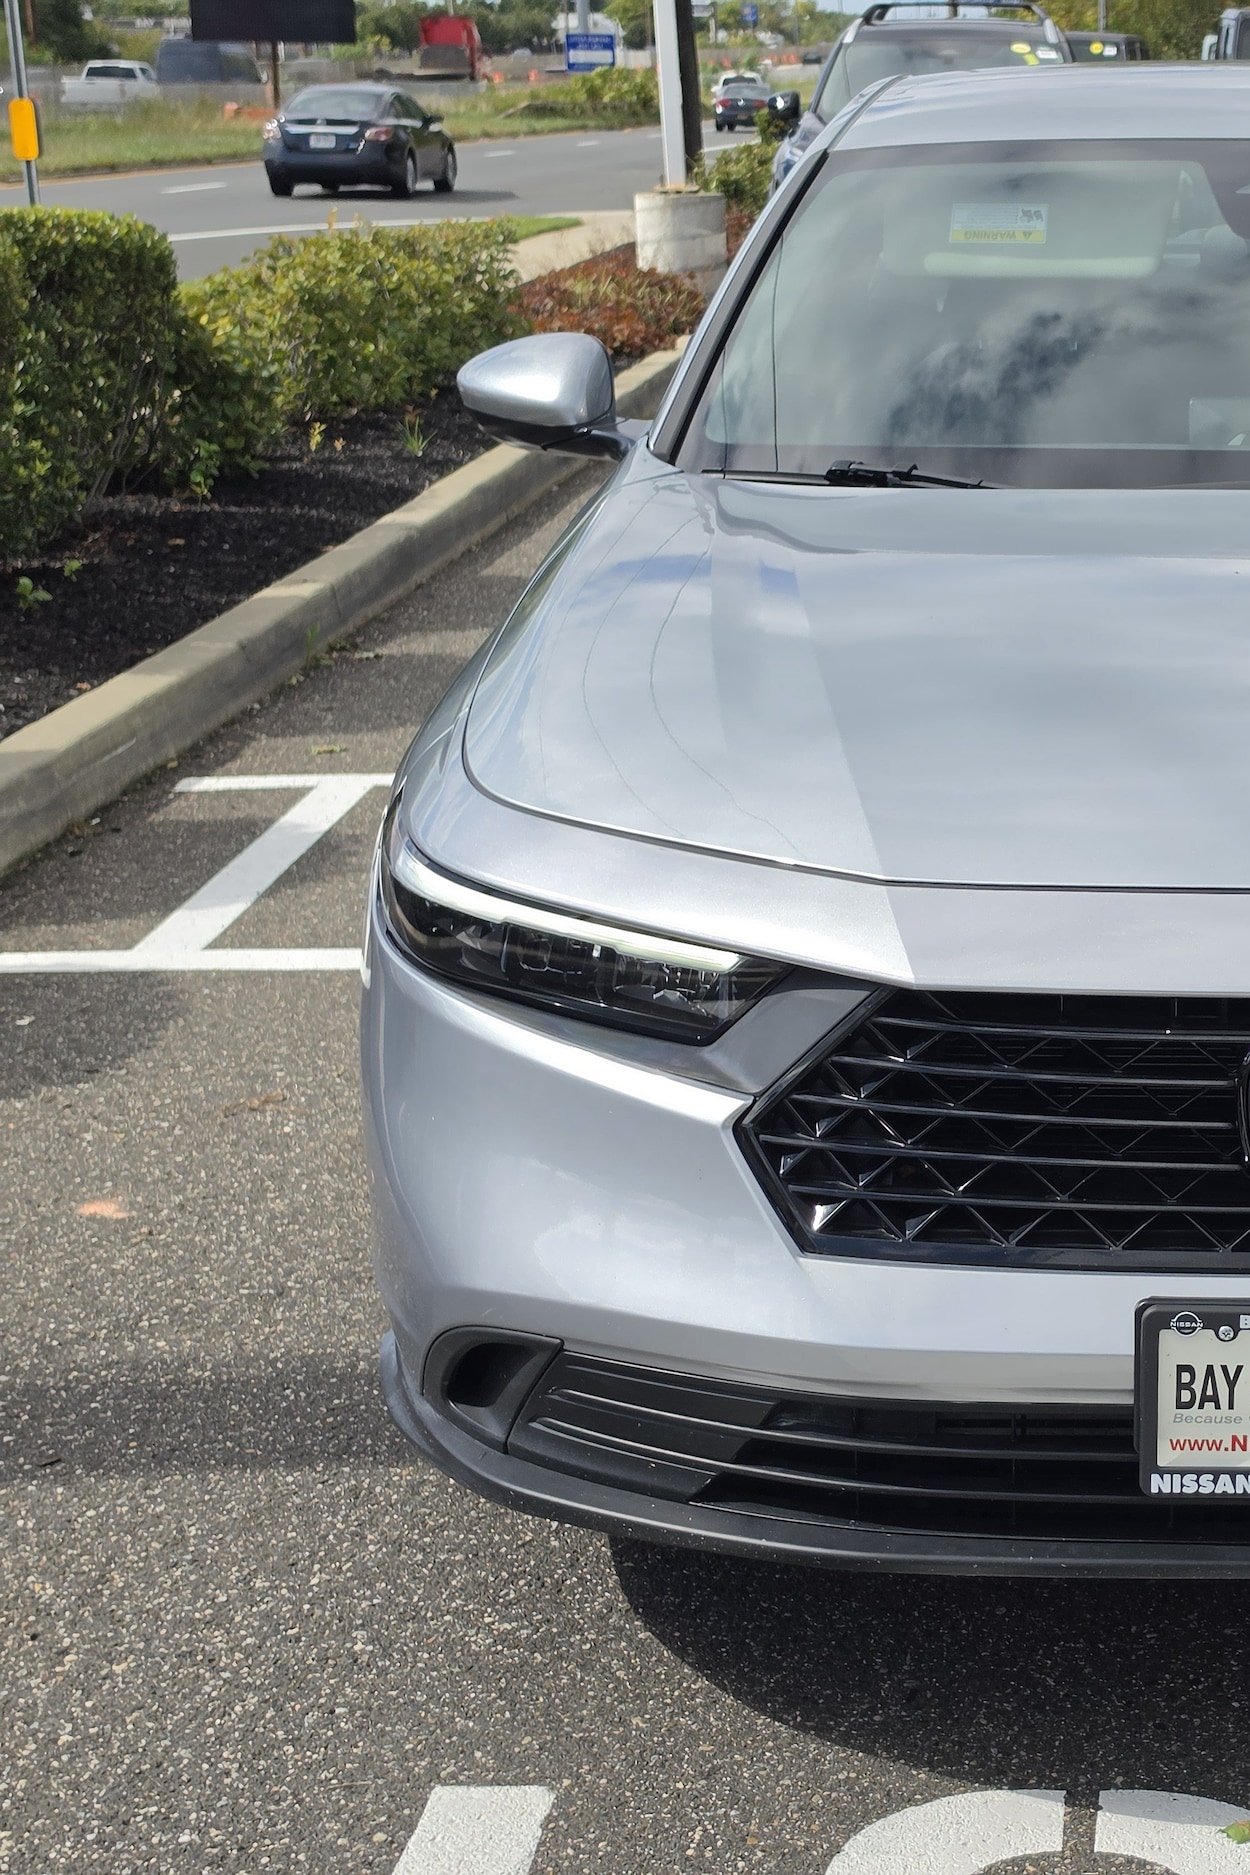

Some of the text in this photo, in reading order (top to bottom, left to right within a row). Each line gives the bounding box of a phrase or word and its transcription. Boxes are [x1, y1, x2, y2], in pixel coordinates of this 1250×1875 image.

[963, 230, 1017, 241] WARNING
[1169, 1321, 1204, 1329] NISSAN
[1175, 1364, 1245, 1411] BAY
[1172, 1412, 1243, 1425] Because
